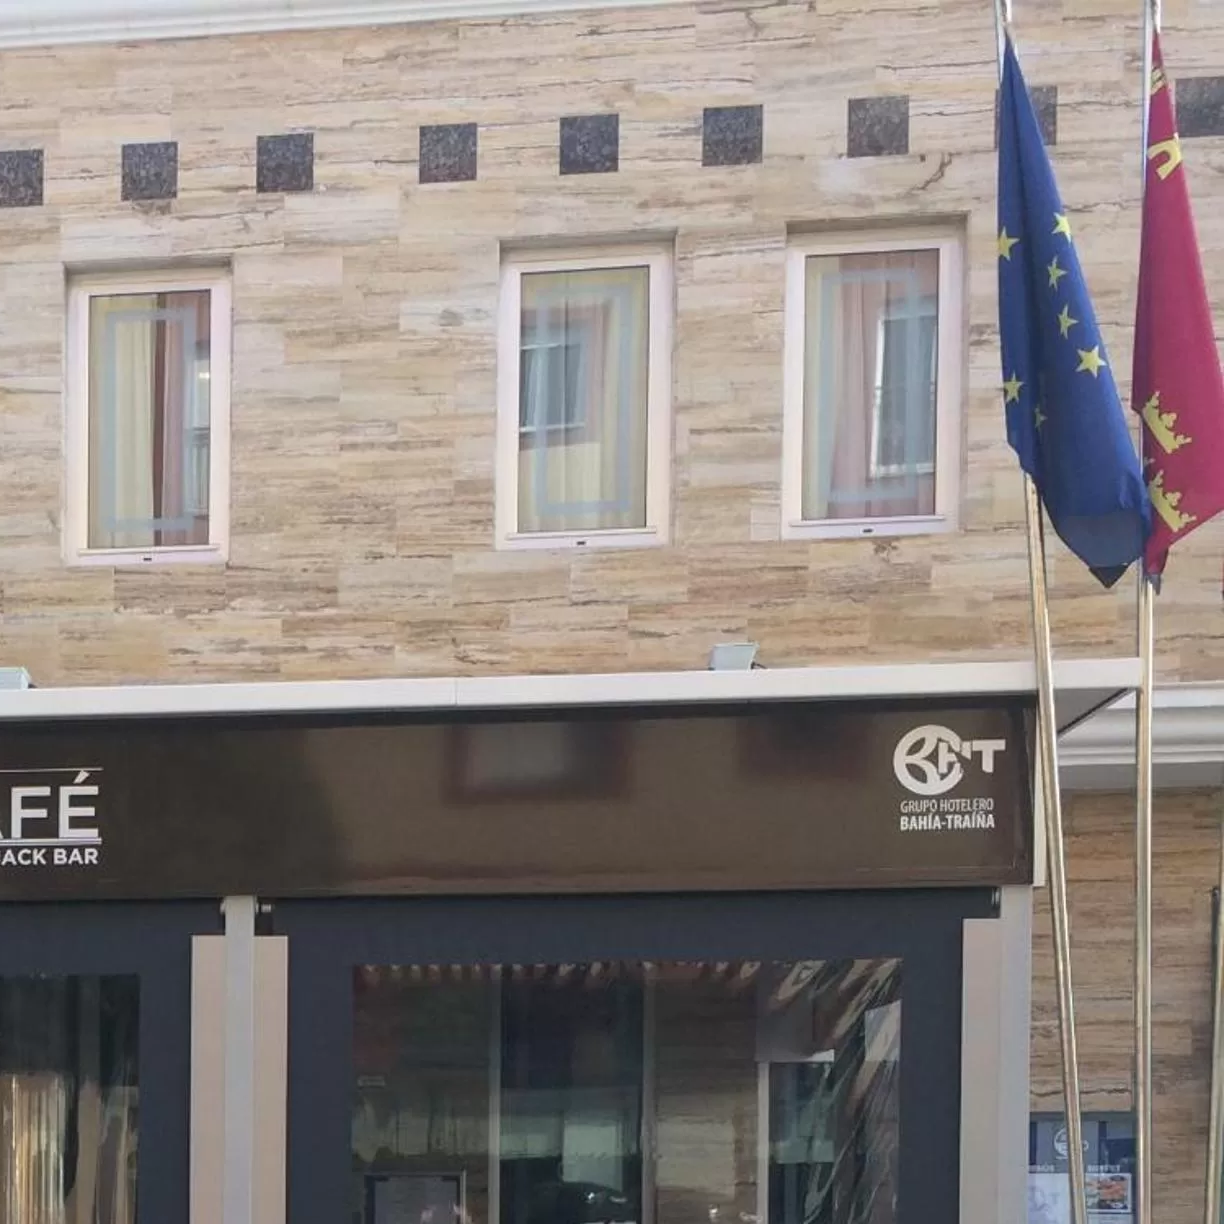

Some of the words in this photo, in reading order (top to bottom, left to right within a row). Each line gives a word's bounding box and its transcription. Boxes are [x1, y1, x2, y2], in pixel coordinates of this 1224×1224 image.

[899, 799, 938, 814] GRUPO
[940, 797, 994, 813] HOTELERO
[53, 847, 99, 866] BAR
